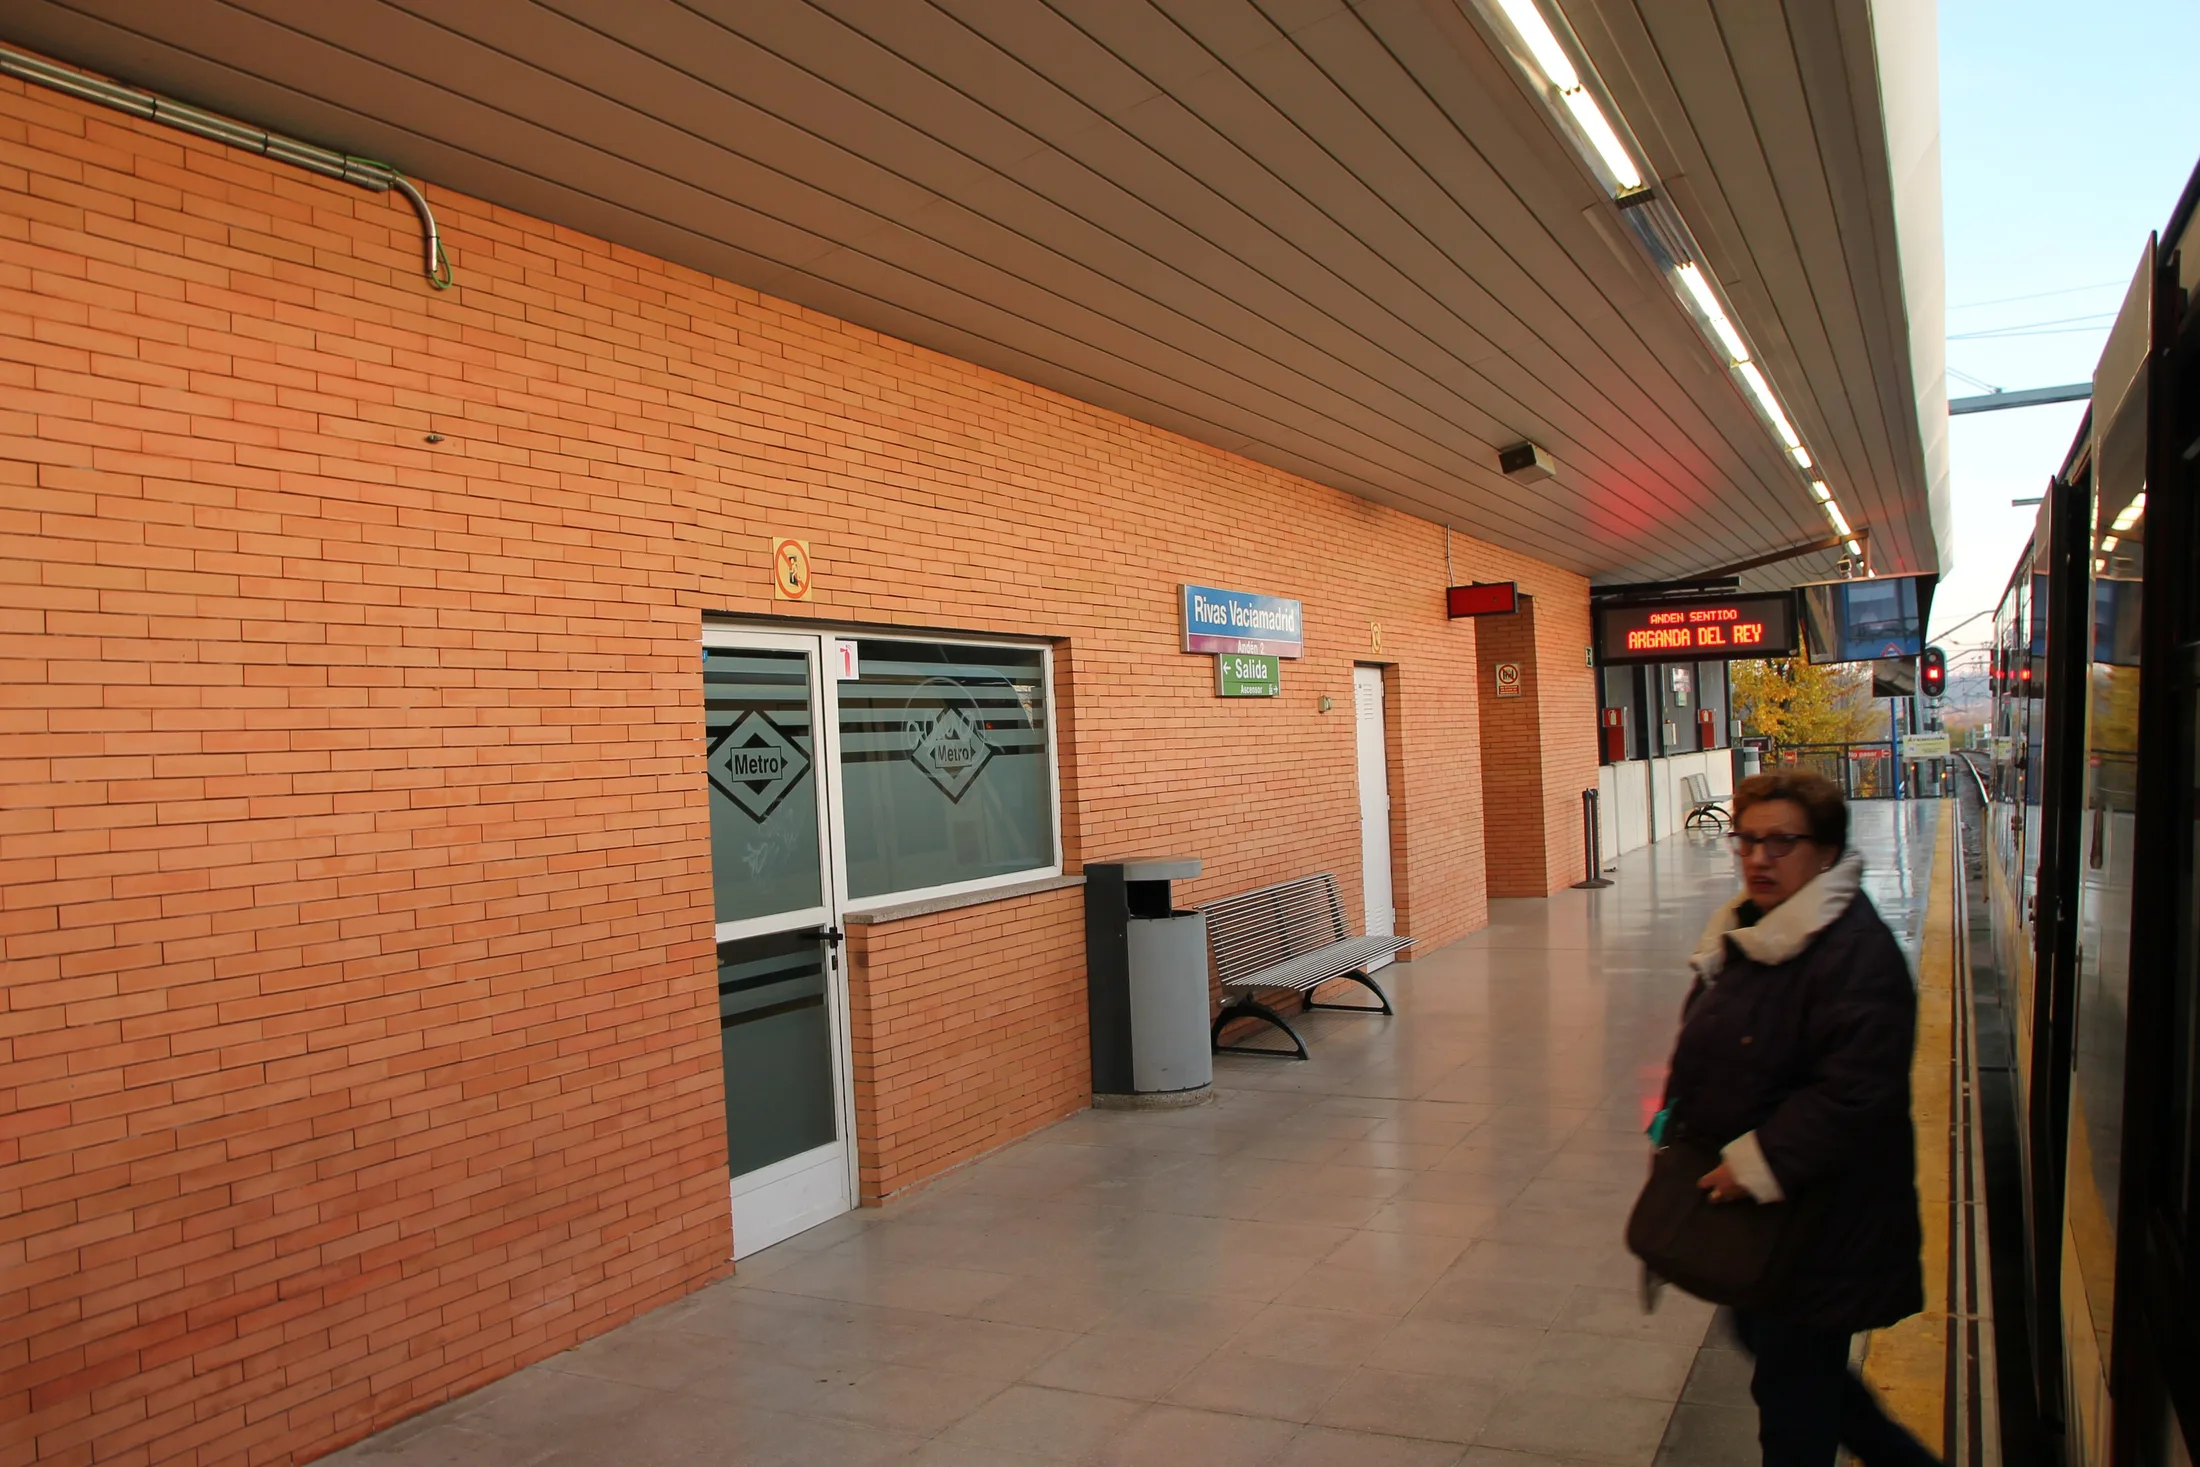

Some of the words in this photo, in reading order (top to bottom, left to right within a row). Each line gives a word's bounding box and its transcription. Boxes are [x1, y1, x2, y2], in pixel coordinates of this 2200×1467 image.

[1194, 595, 1228, 625] Rivas
[1229, 600, 1295, 632] Vaciamadrid
[1650, 612, 1685, 624] ANDEN
[1689, 609, 1738, 622] SENTIDO
[1628, 628, 1691, 650] ARGANDA
[1698, 626, 1726, 646] DEL
[1733, 624, 1762, 644] REY
[1235, 658, 1268, 679] Salida
[938, 744, 970, 762] Metro
[734, 755, 779, 775] Metro
